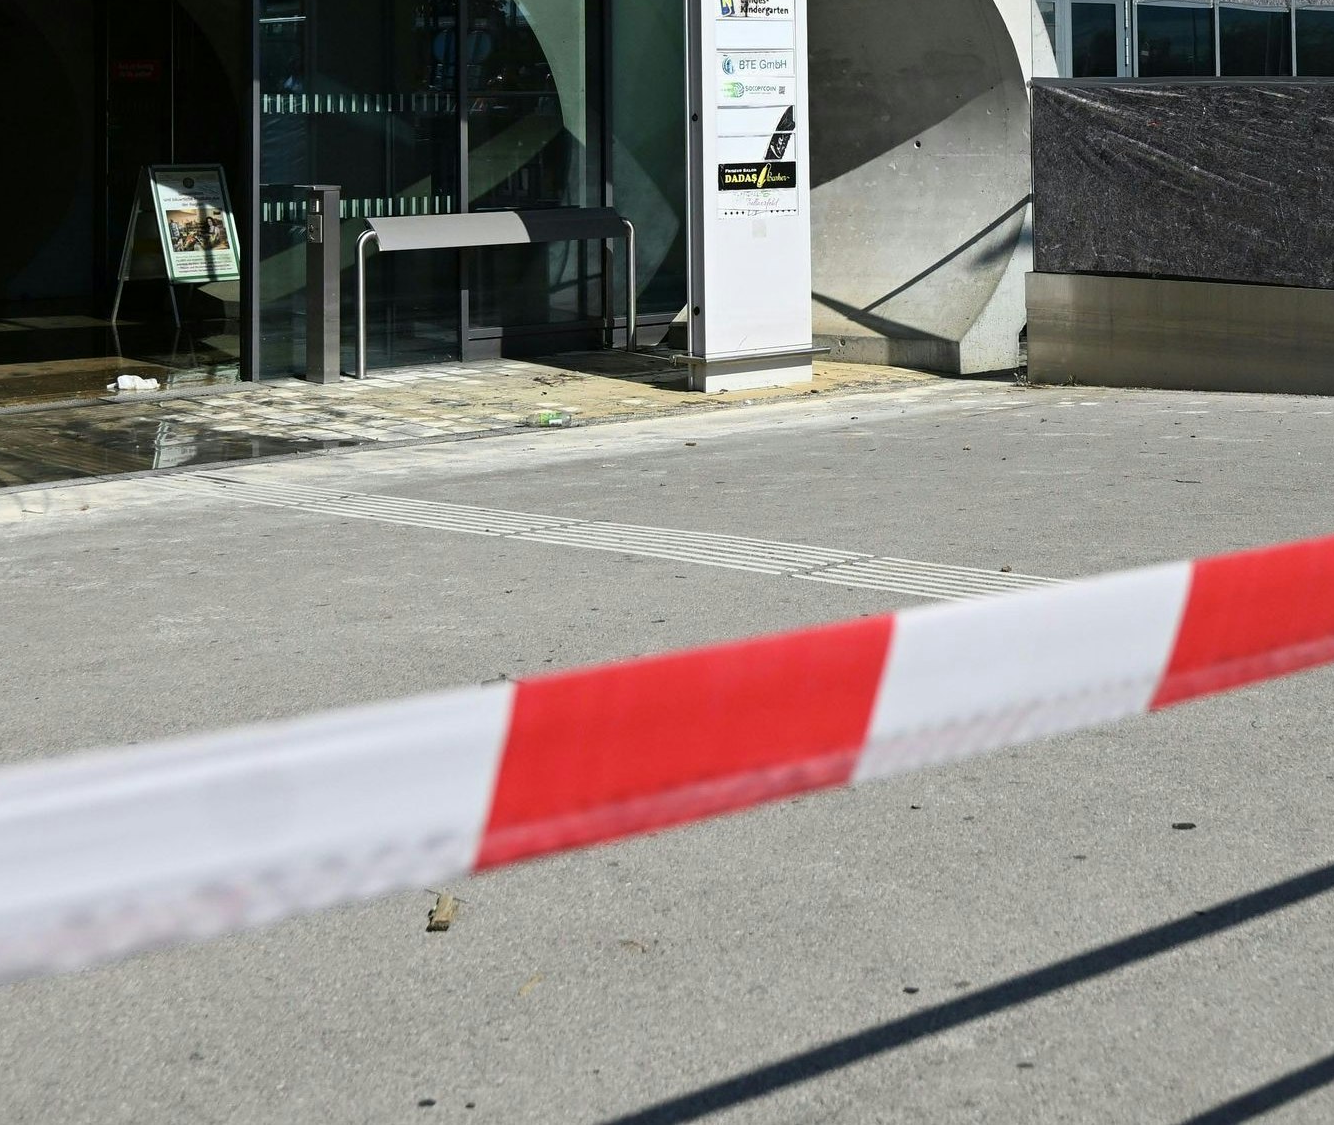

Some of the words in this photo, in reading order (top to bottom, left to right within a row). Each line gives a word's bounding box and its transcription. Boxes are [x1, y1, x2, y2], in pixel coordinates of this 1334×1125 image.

[740, 5, 789, 16] Kindergarten
[739, 59, 757, 69] BTE
[759, 59, 787, 69] GmbH
